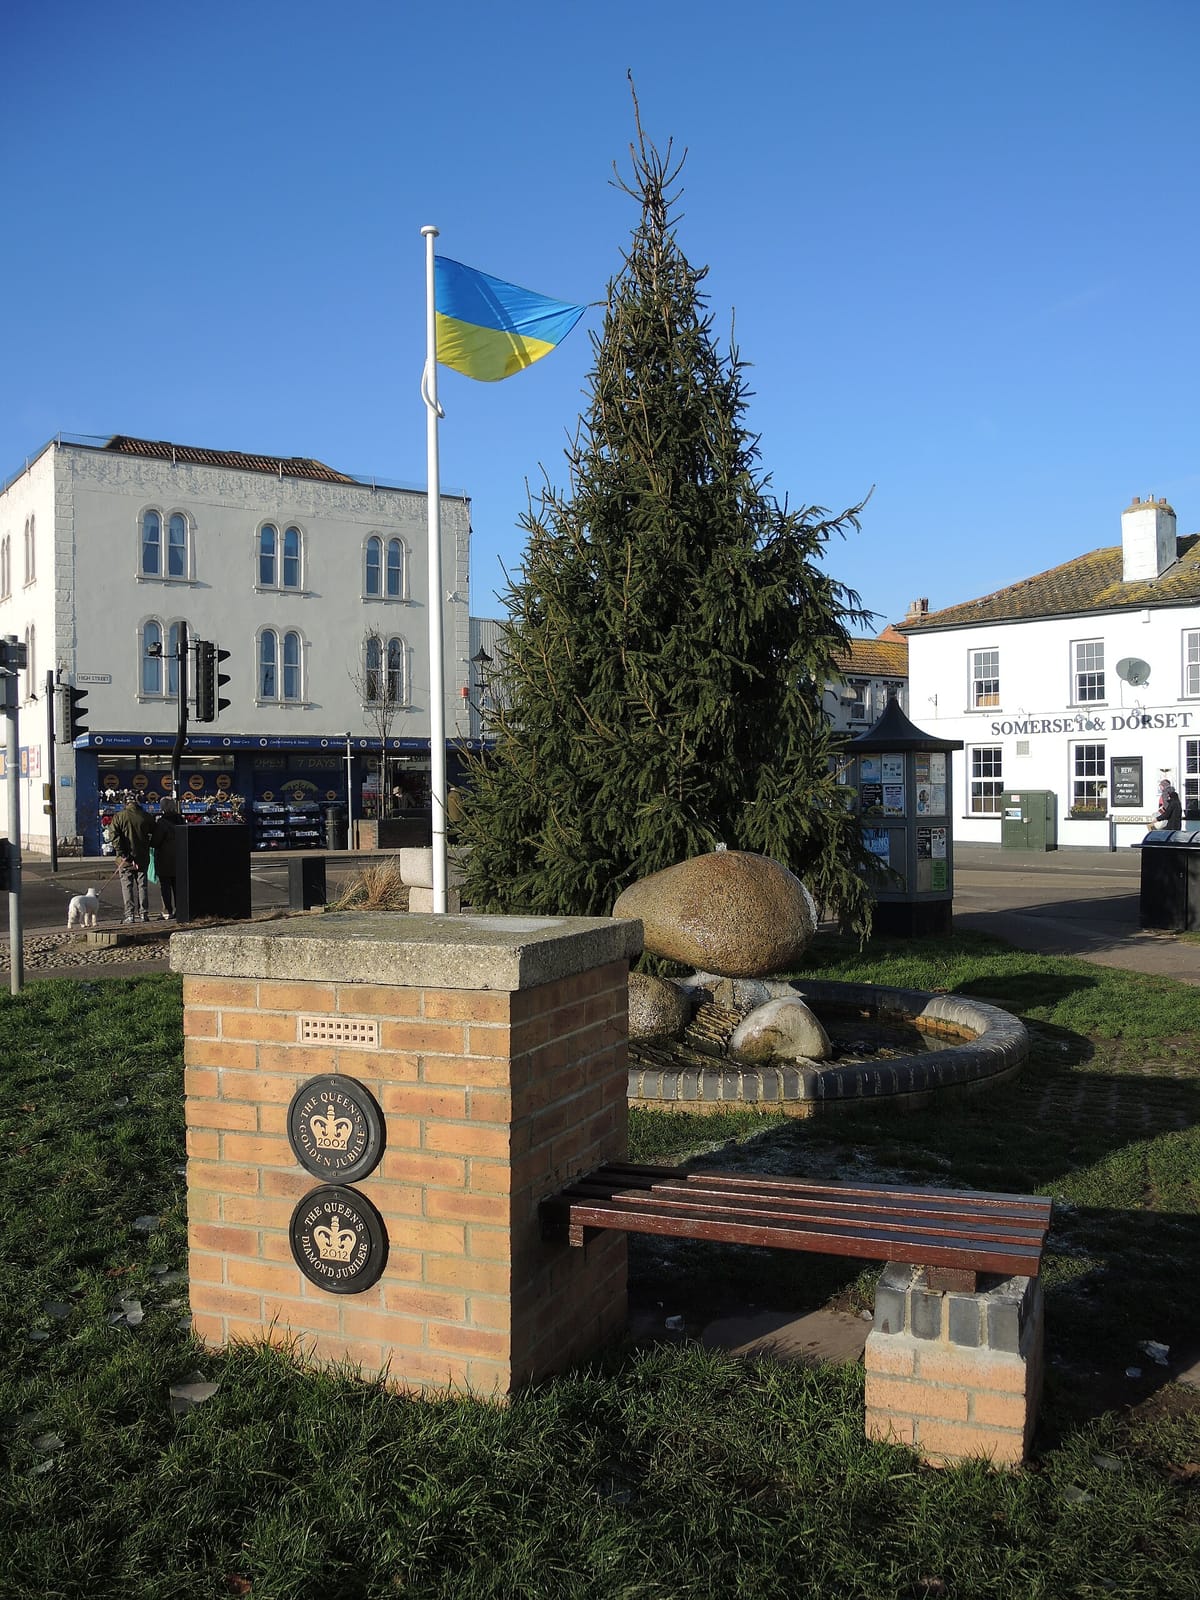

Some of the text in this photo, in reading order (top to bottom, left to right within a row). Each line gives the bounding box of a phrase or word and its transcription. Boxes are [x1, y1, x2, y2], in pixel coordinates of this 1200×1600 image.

[991, 712, 1193, 736] SOMERSET & DORSET
[308, 759, 336, 768] DAYS
[301, 1092, 363, 1123] THE QUEEN'S
[299, 1125, 365, 1168] GOLDEN JUBILEE
[318, 1138, 346, 1149] 2002
[304, 1202, 364, 1232] THE QUEEN'S
[301, 1236, 368, 1279] DIAMOND JUBILEE
[322, 1248, 348, 1260] 2012
